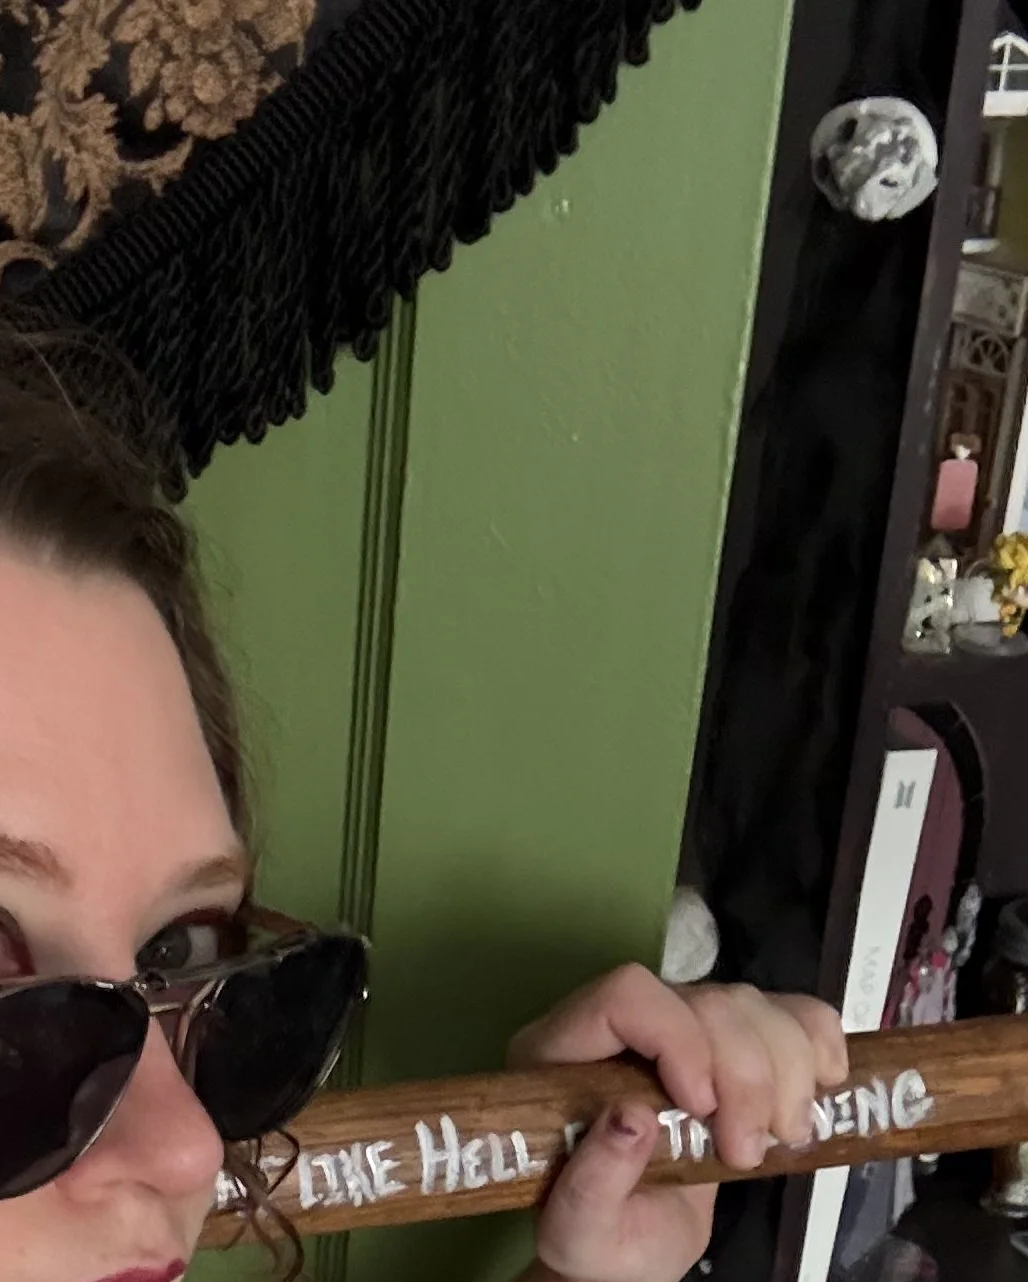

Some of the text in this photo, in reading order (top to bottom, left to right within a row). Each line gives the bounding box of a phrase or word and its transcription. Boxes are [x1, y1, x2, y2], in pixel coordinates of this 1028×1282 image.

[298, 1140, 408, 1210] LIKE
[414, 1112, 549, 1196] HELL
[810, 1067, 934, 1142] VING
